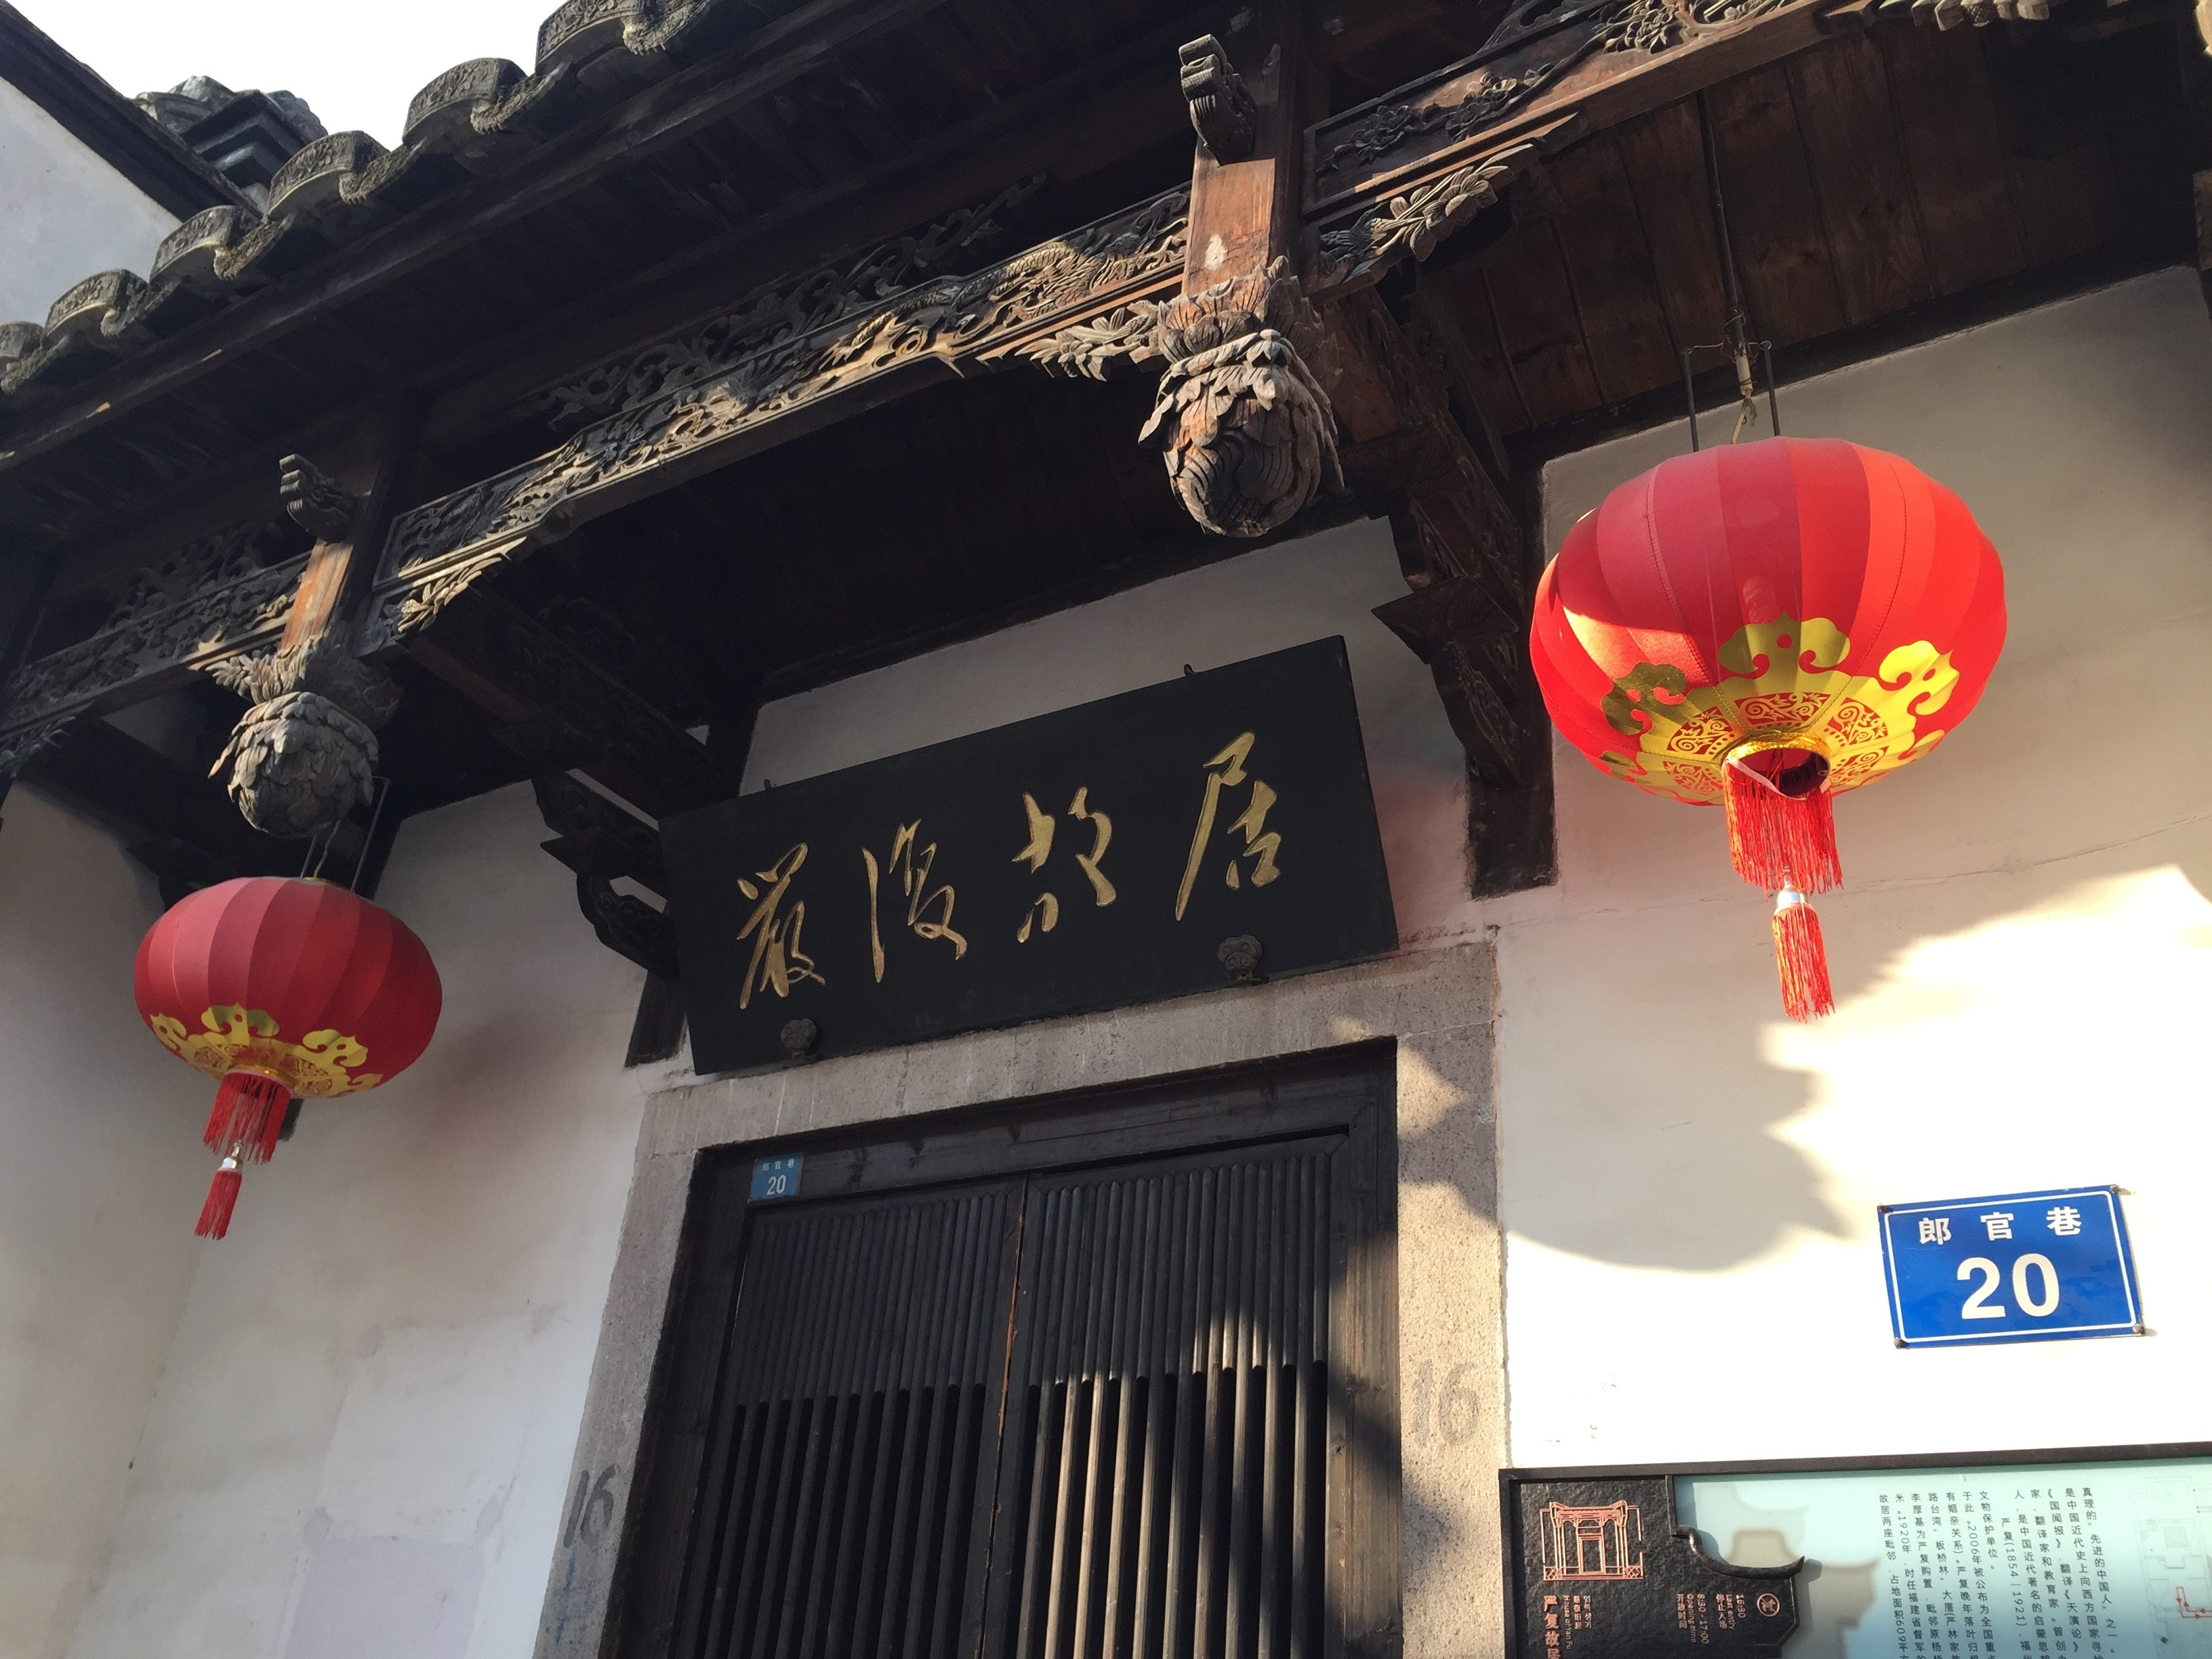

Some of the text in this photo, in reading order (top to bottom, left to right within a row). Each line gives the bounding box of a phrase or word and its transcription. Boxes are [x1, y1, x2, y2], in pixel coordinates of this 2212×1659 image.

[766, 1174, 787, 1195] 20
[1919, 1206, 2083, 1246] 郎官巷
[1957, 1252, 2060, 1320] 20
[1412, 1358, 1480, 1449] 16
[563, 1463, 621, 1549] 16
[1677, 1593, 1688, 1629] 开放时间
[1697, 1593, 1706, 1612] 8:30
[1715, 1593, 1728, 1630] 停止入场
[1736, 1594, 1746, 1618] 16:30
[1543, 1595, 1561, 1659] 严复故居
[1699, 1620, 1709, 1644] 17:00
[1566, 1641, 1574, 1650] Fu
